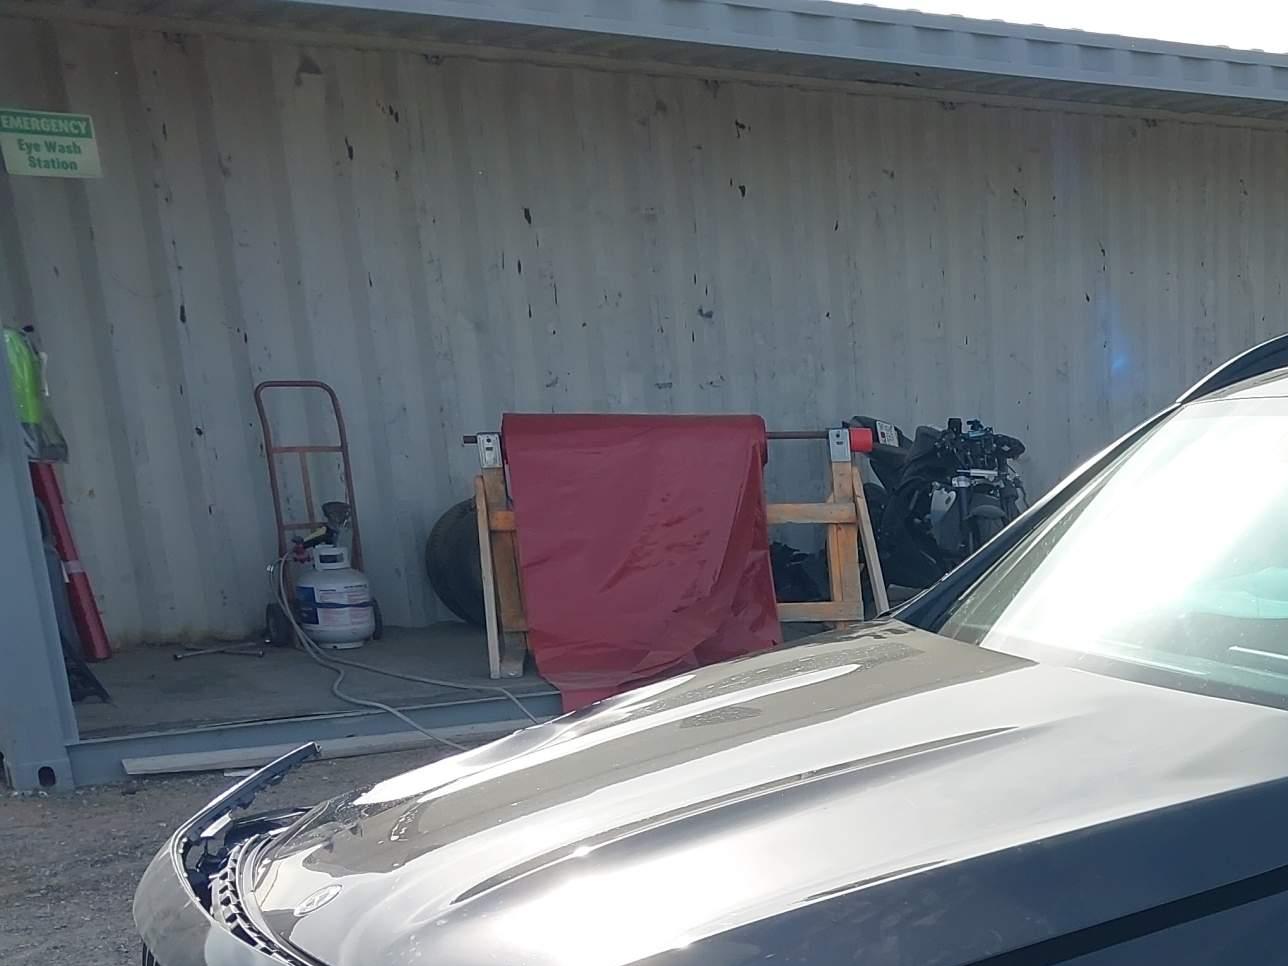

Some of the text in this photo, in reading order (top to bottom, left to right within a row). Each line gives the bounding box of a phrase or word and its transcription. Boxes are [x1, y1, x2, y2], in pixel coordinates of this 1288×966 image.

[0, 115, 88, 135] EMERGENCY
[17, 138, 82, 155] Eye Wash
[28, 155, 78, 171] Station
